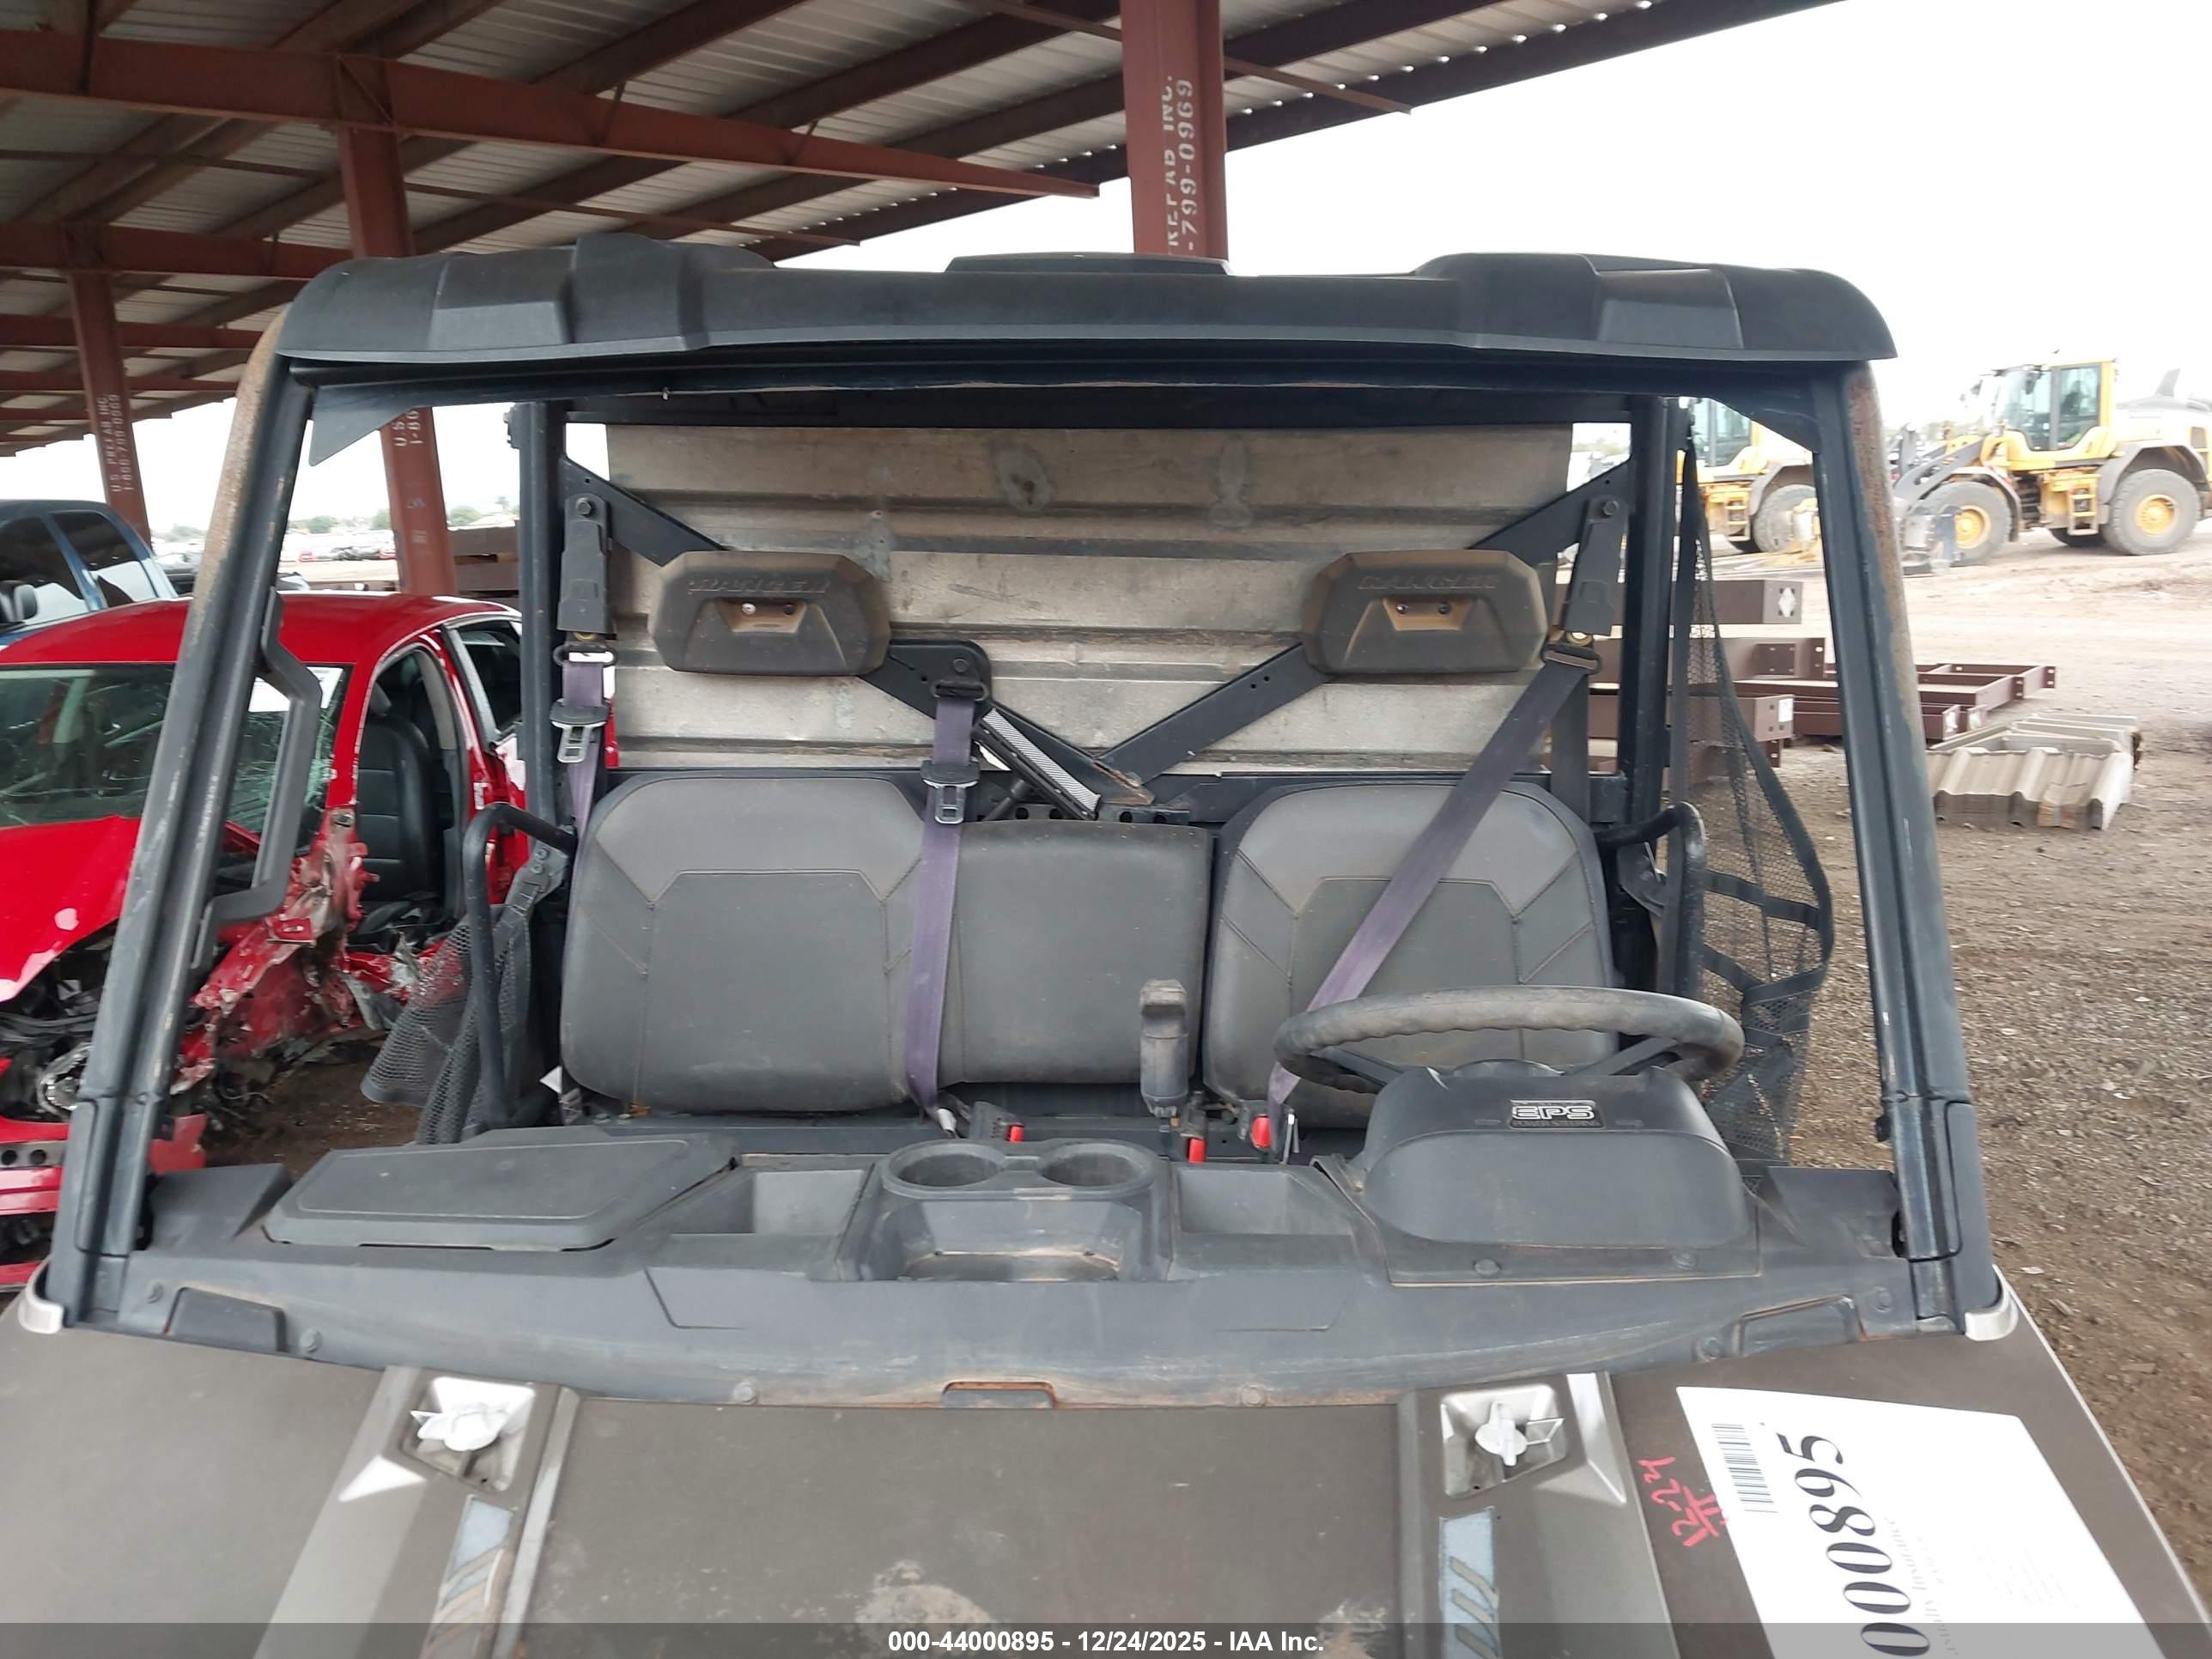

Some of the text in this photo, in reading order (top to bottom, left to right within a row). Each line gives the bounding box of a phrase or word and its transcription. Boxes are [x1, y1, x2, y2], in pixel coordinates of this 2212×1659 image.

[1161, 75, 1179, 255] REFAB INC.
[1176, 79, 1198, 251] -799-0969
[1511, 1105, 1595, 1121] EPS
